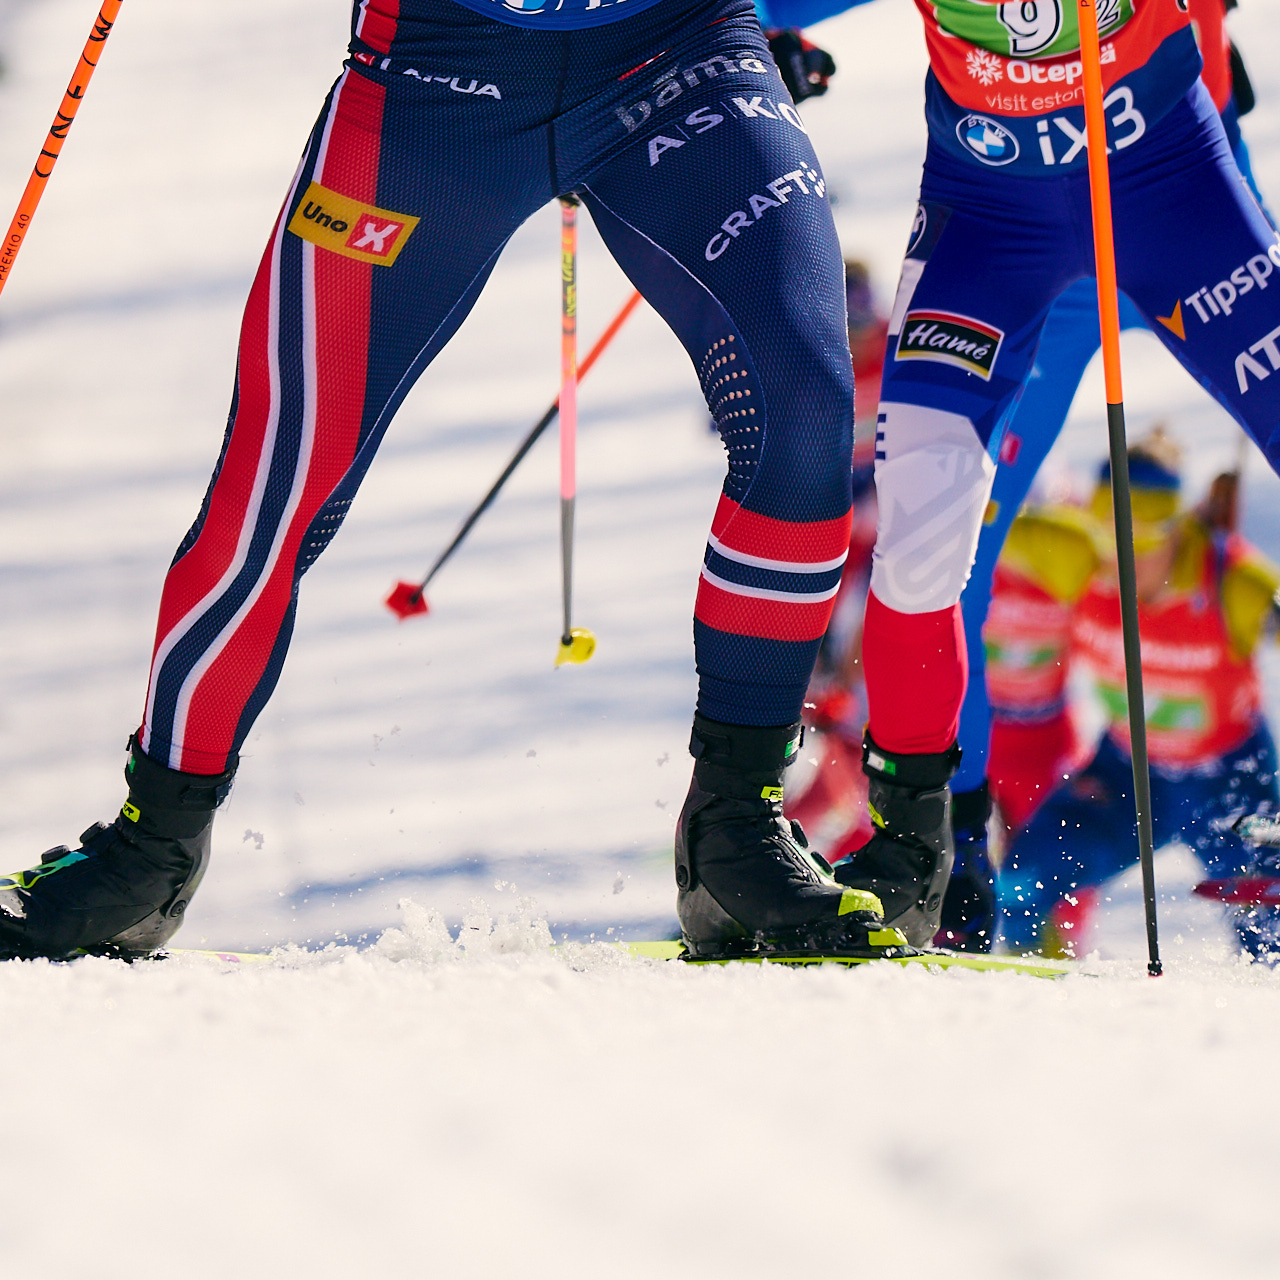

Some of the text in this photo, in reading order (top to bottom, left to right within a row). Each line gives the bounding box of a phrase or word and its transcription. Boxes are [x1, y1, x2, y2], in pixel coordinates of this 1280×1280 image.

[1006, 43, 1116, 86] Otepä
[985, 94, 1029, 113] visit
[1036, 86, 1147, 166] iX3
[19, 213, 30, 229] 40
[302, 201, 400, 254] Uno X
[705, 169, 811, 262] CRAFT
[906, 321, 989, 362] Hamé
